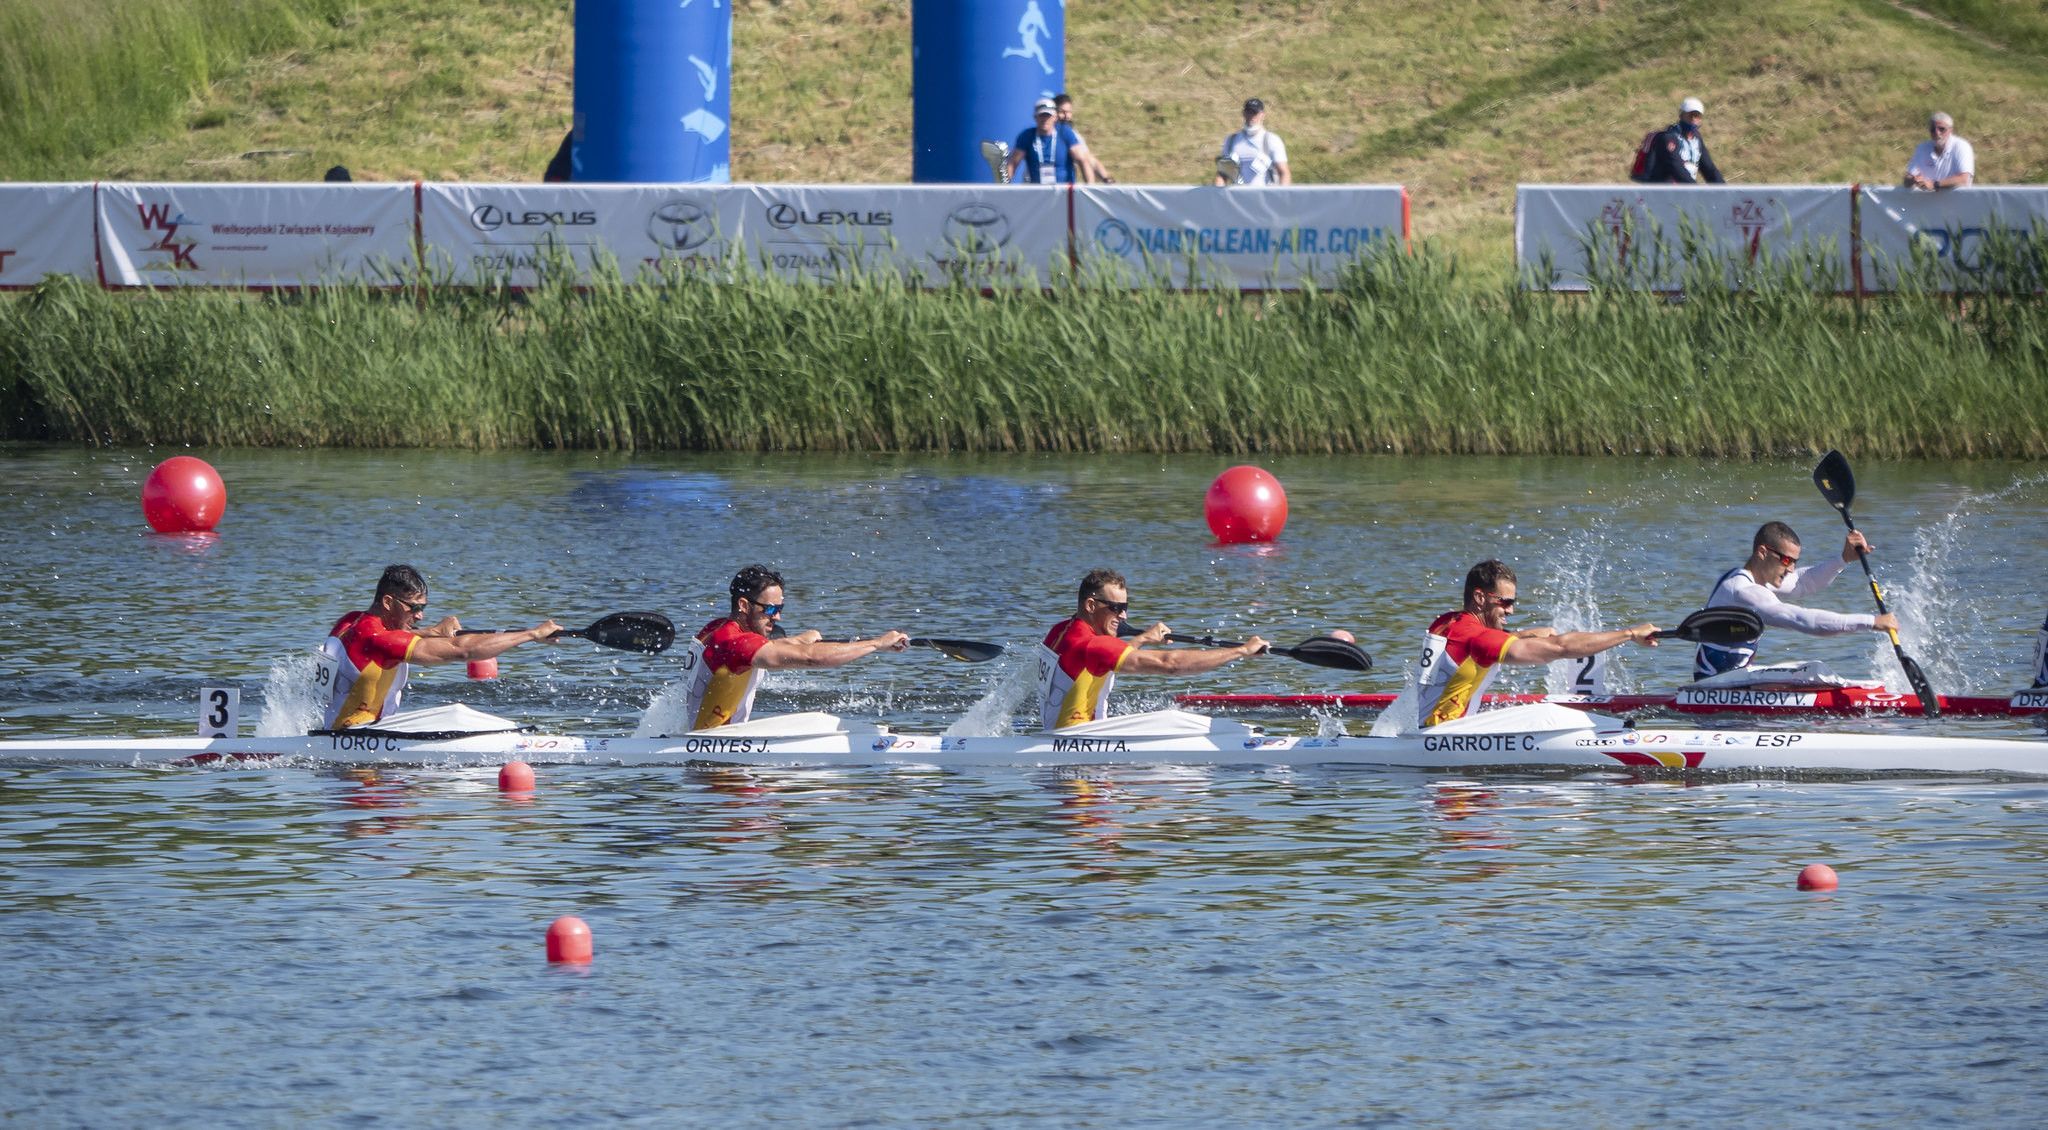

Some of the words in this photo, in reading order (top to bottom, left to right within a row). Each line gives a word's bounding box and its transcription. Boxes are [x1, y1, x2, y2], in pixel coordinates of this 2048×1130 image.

[506, 211, 597, 226] LEXUS
[800, 210, 894, 226] LEXUS
[211, 224, 278, 237] Wielkopolski
[325, 224, 375, 237] Kajakowy
[1576, 655, 1596, 686] 2
[1684, 690, 1792, 705] TORUBAROV
[1793, 692, 1806, 706] V.
[208, 689, 229, 729] 3
[331, 735, 380, 750] TORO
[385, 736, 400, 751] C.
[686, 738, 752, 753] ORIYES
[756, 739, 771, 753] J.
[1052, 738, 1111, 752] MARTI
[1113, 739, 1131, 752] A.
[1424, 735, 1516, 751] GARROTE
[1522, 735, 1540, 751] C.
[1755, 734, 1802, 747] ESP
